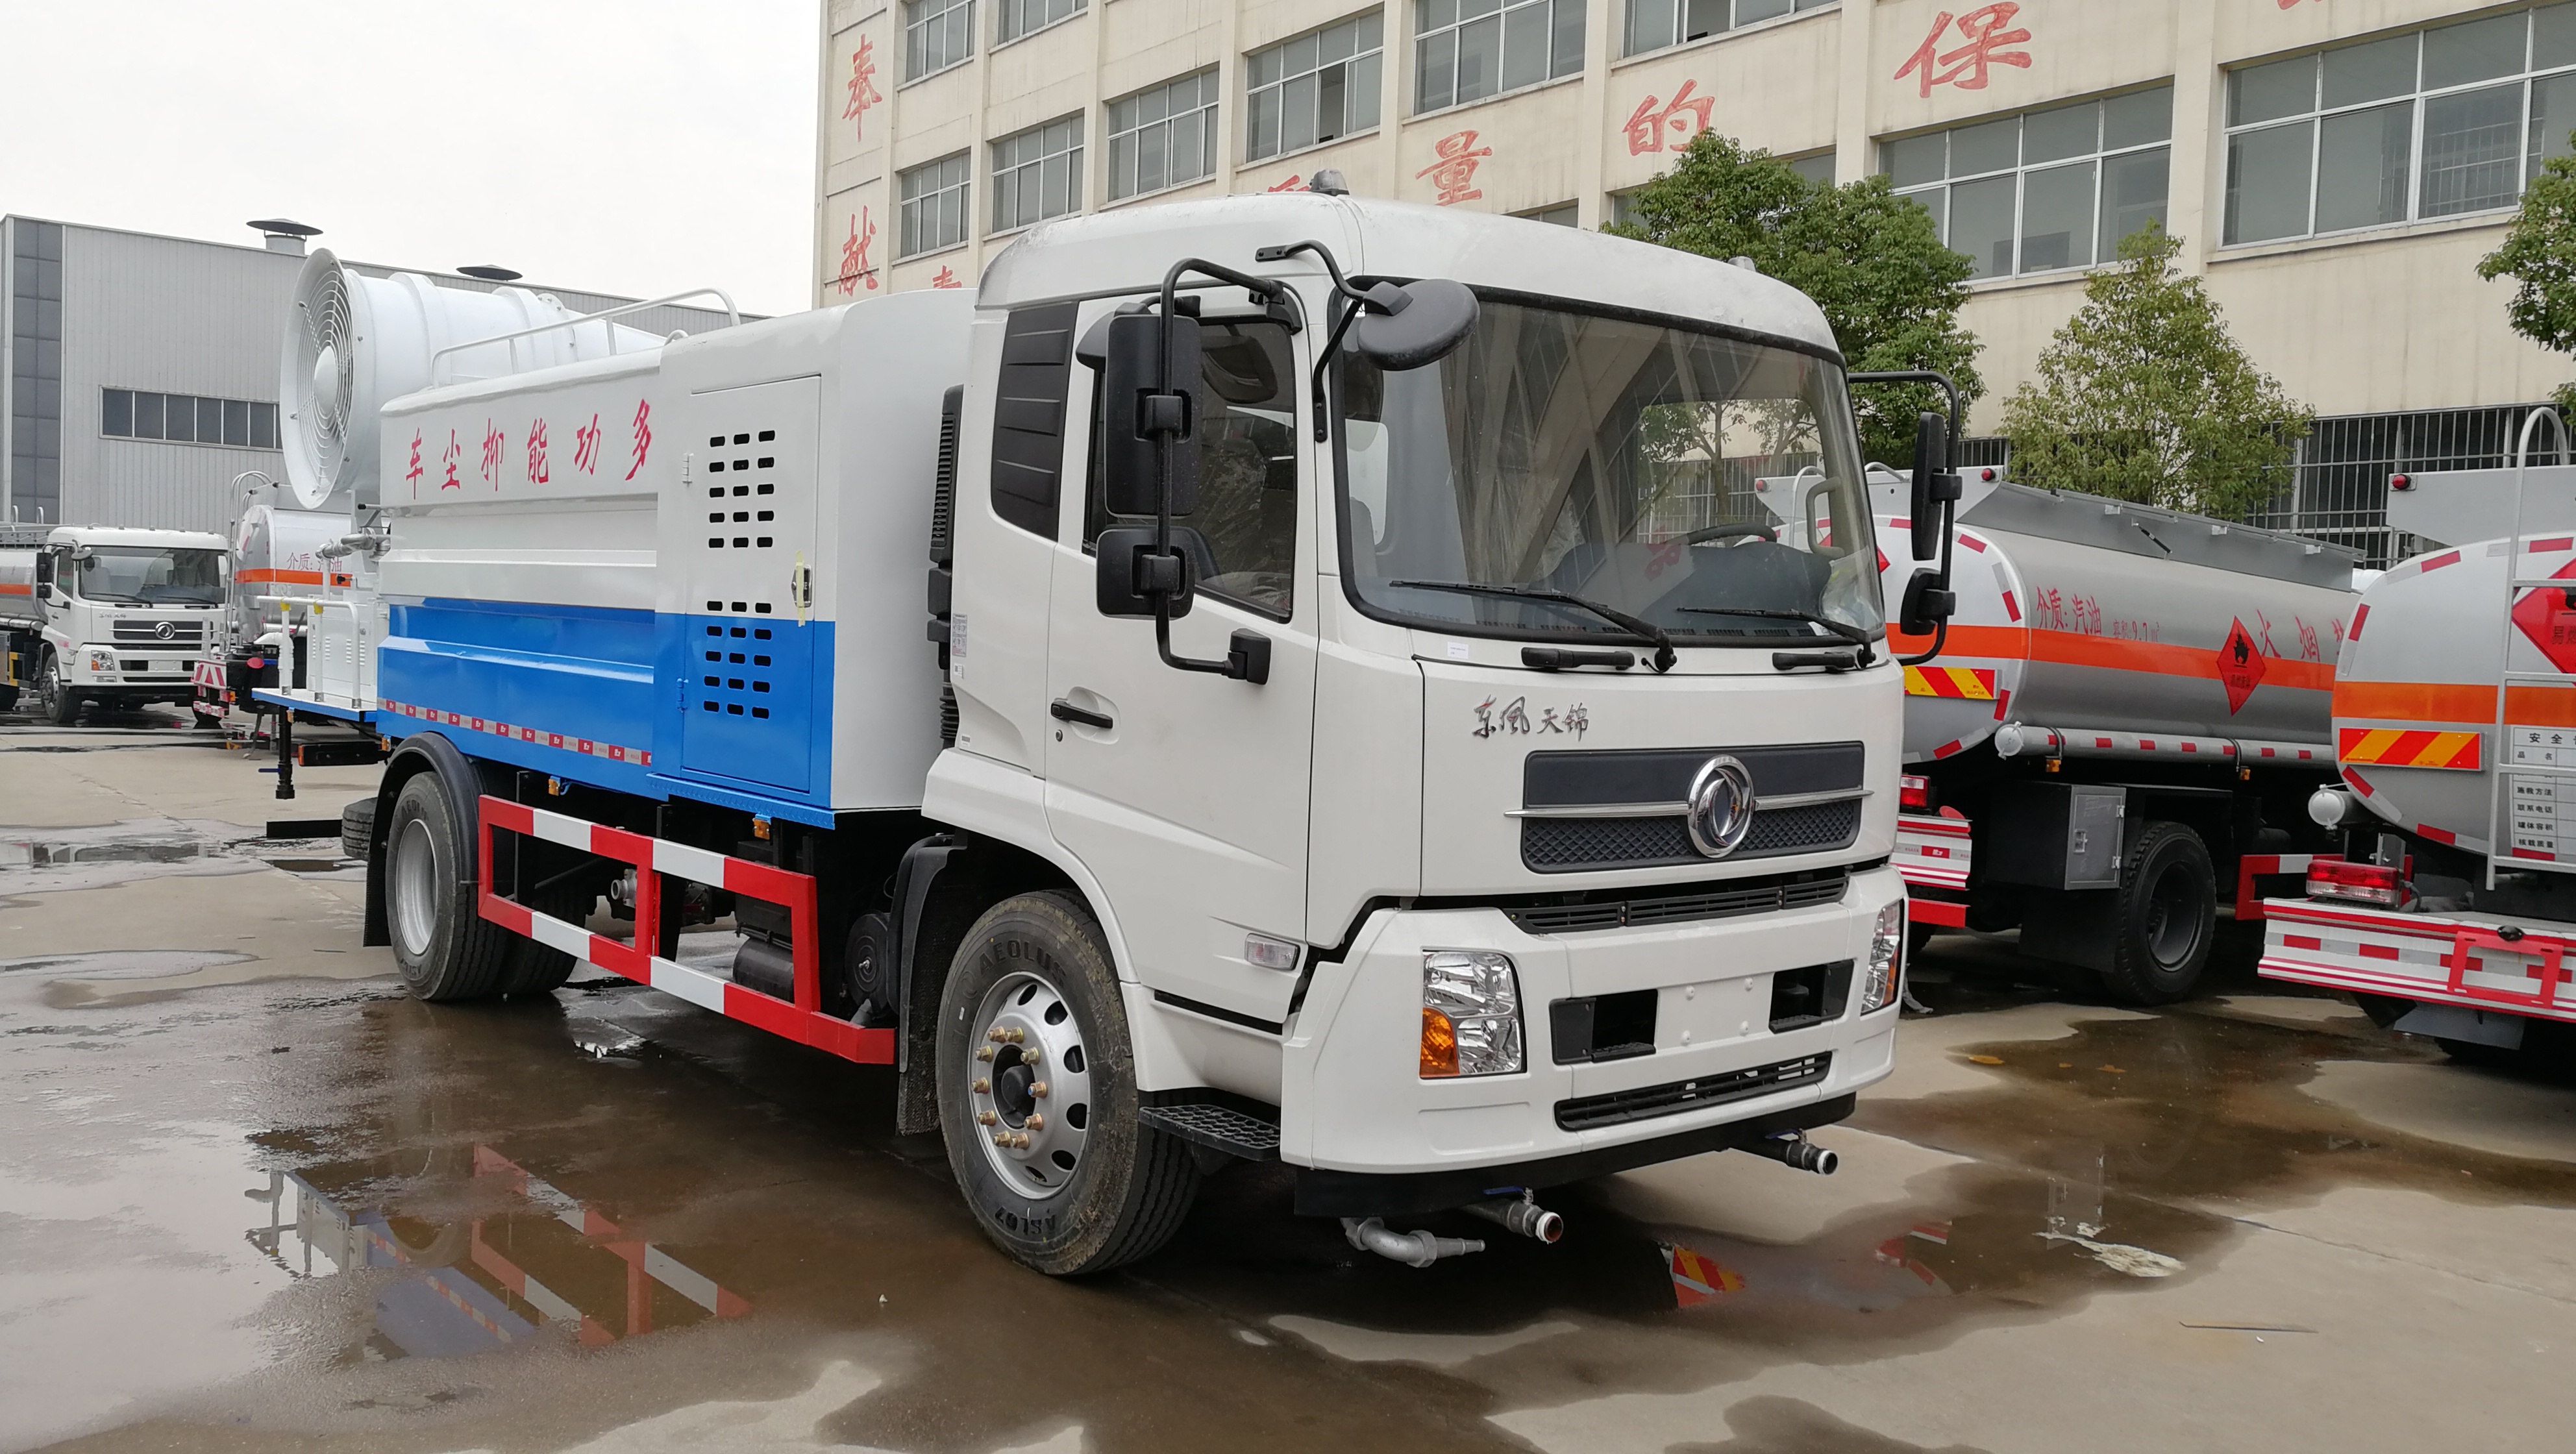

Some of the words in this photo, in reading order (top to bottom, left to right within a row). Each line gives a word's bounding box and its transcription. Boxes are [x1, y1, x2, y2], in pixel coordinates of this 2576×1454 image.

[1893, 1, 2033, 98] 保
[1415, 129, 1492, 206] 量
[2529, 732, 2576, 745] 安全
[978, 939, 1067, 989] AEOLUS
